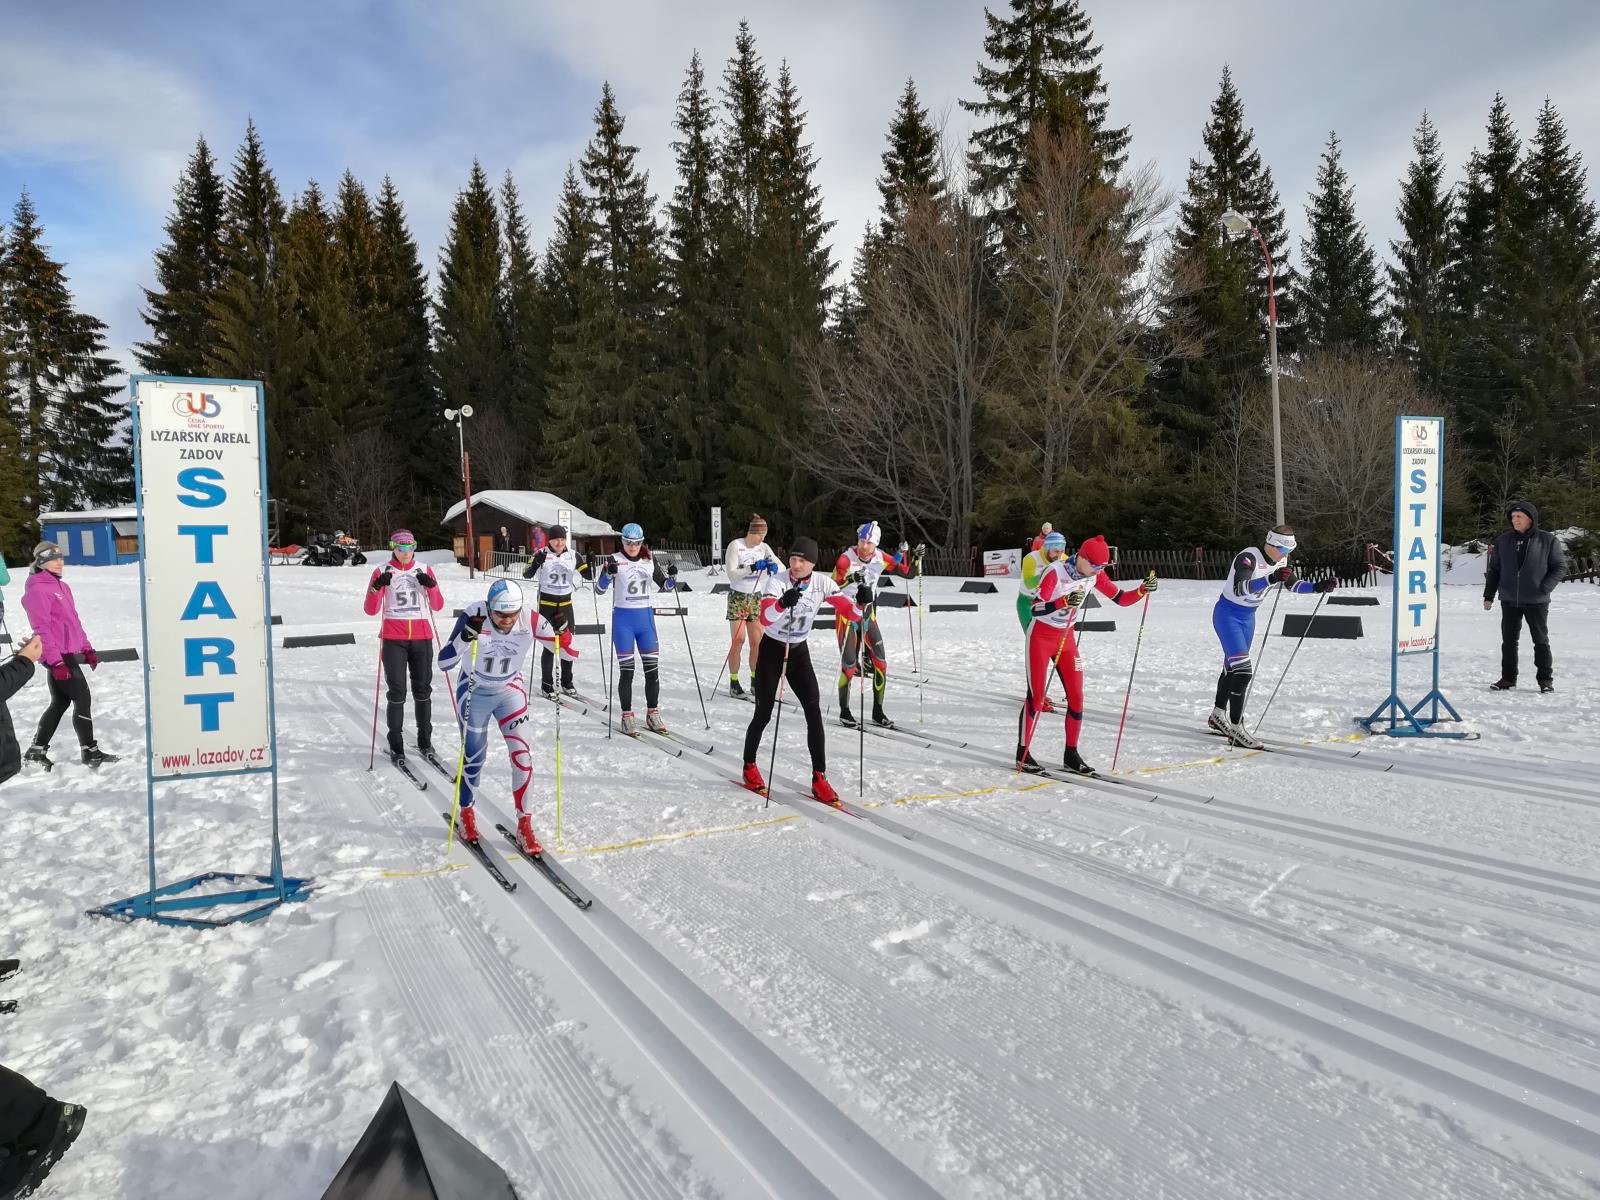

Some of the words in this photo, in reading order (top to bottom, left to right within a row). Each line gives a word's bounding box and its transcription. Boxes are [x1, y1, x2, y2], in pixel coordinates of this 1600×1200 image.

[179, 448, 224, 461] ZADOV
[1408, 468, 1428, 628] START
[549, 573, 567, 585] 91
[627, 580, 647, 595] 61
[176, 466, 239, 732] START
[395, 590, 418, 606] 51
[781, 615, 807, 632] 21
[483, 656, 511, 674] 11
[161, 744, 265, 769] www.lazadov.cz
